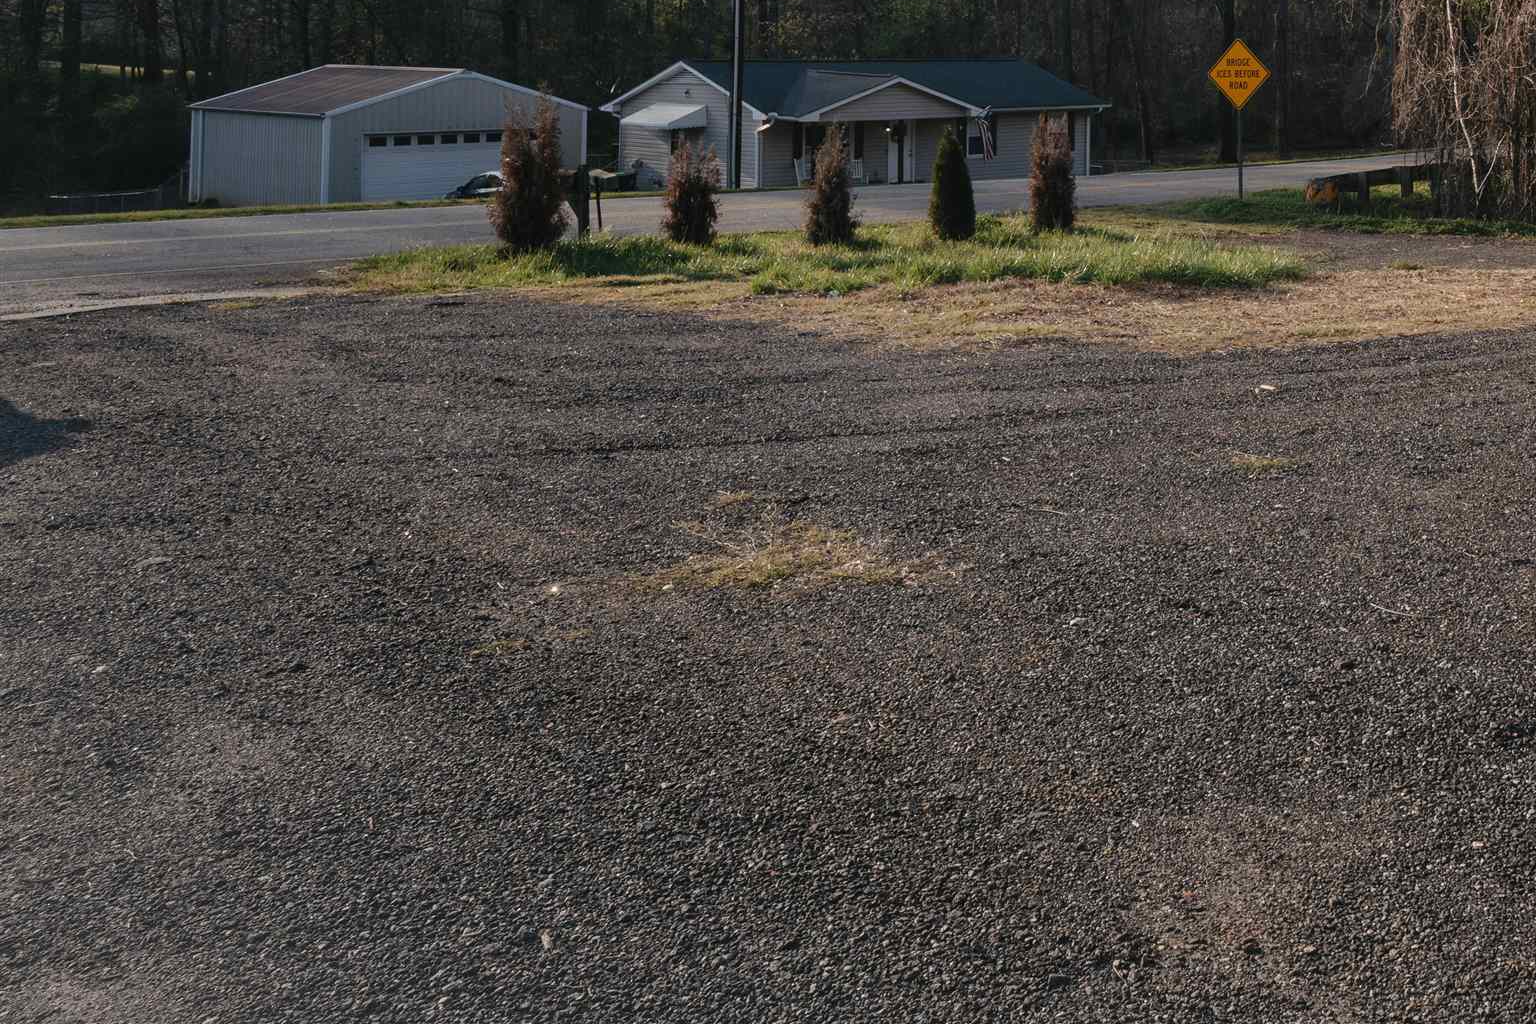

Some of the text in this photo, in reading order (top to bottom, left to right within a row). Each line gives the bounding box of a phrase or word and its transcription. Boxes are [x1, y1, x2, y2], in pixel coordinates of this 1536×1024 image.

[1226, 58, 1251, 67] BRIDGE
[1216, 69, 1260, 78] ICES BEFORE
[1229, 81, 1248, 89] ROAD
